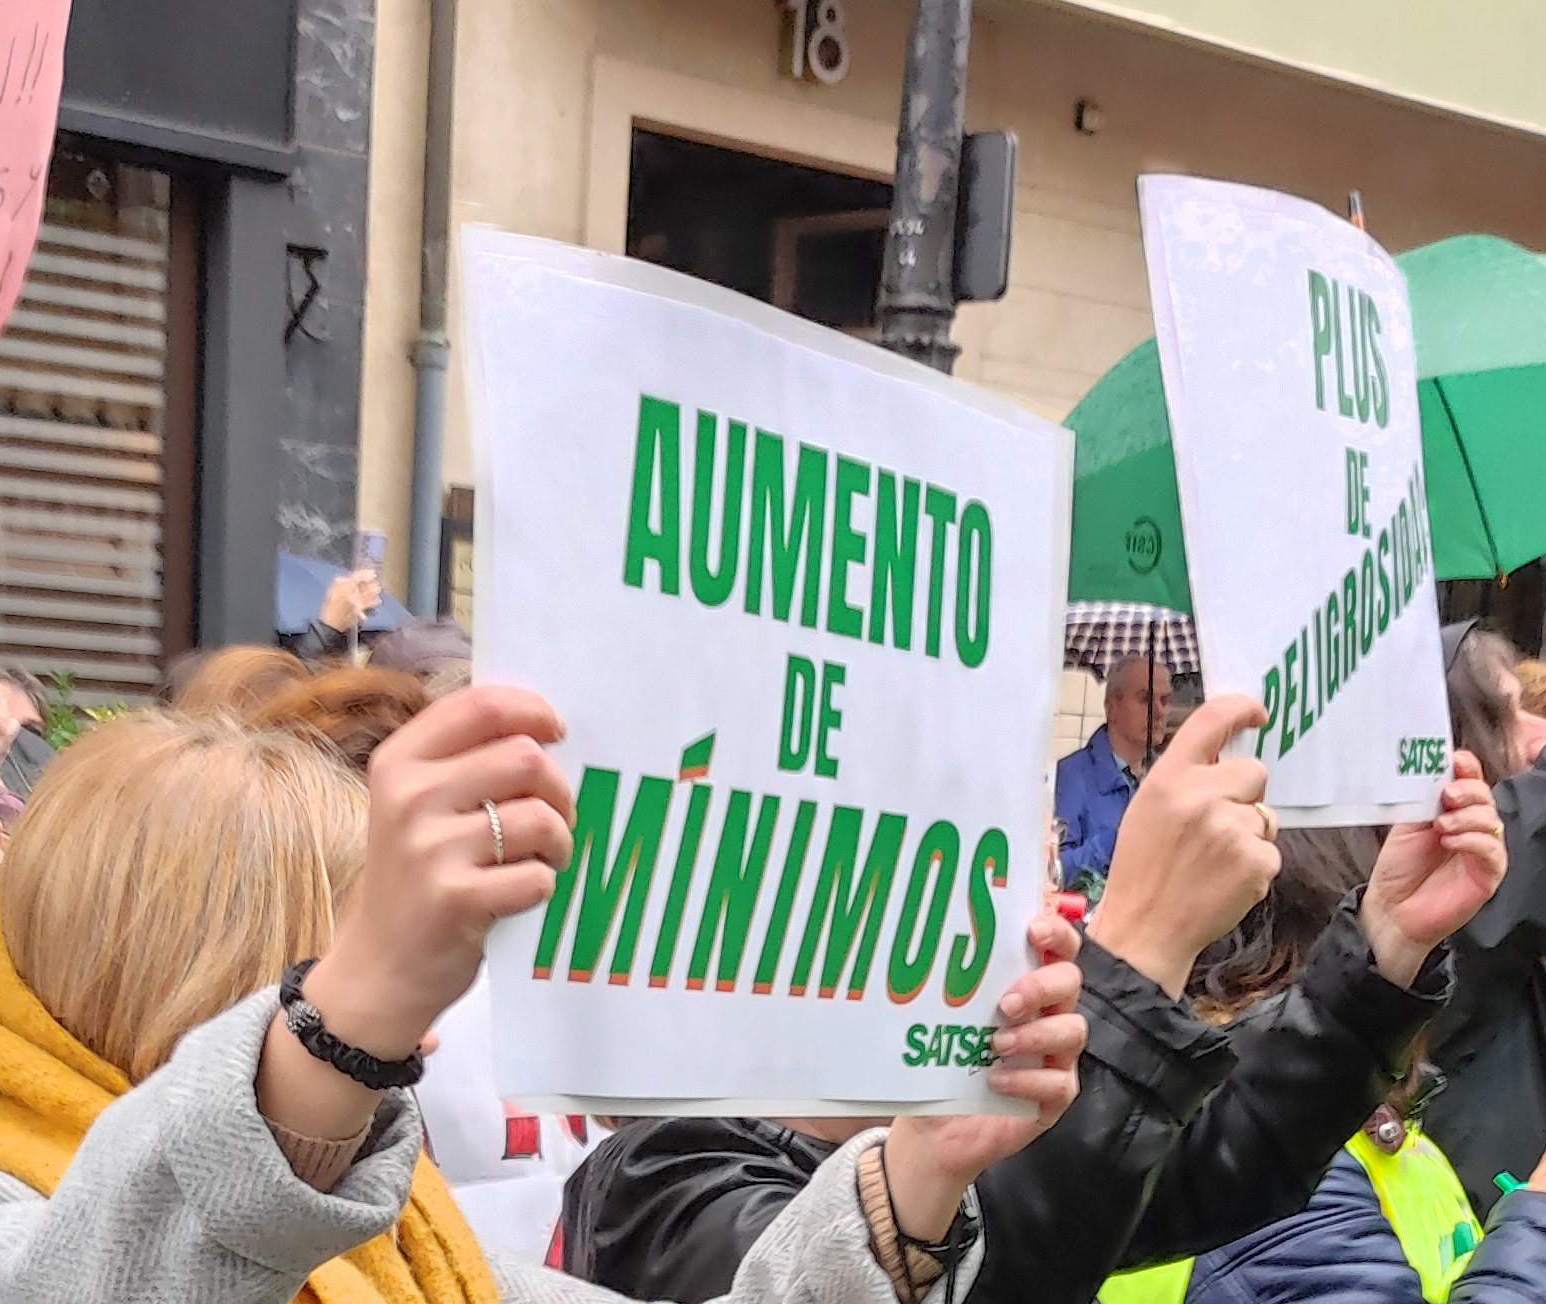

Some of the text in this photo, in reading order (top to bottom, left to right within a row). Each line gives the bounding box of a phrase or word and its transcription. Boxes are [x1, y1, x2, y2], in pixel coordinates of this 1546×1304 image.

[783, 0, 850, 84] 18
[1307, 268, 1391, 430] PLUS
[621, 393, 994, 670] AUMENTO
[1345, 446, 1371, 539] DE
[776, 652, 848, 779] DE
[1396, 736, 1446, 775] SATSE
[530, 730, 1011, 1009] MÍNIMOS
[901, 1022, 999, 1067] SATSE
